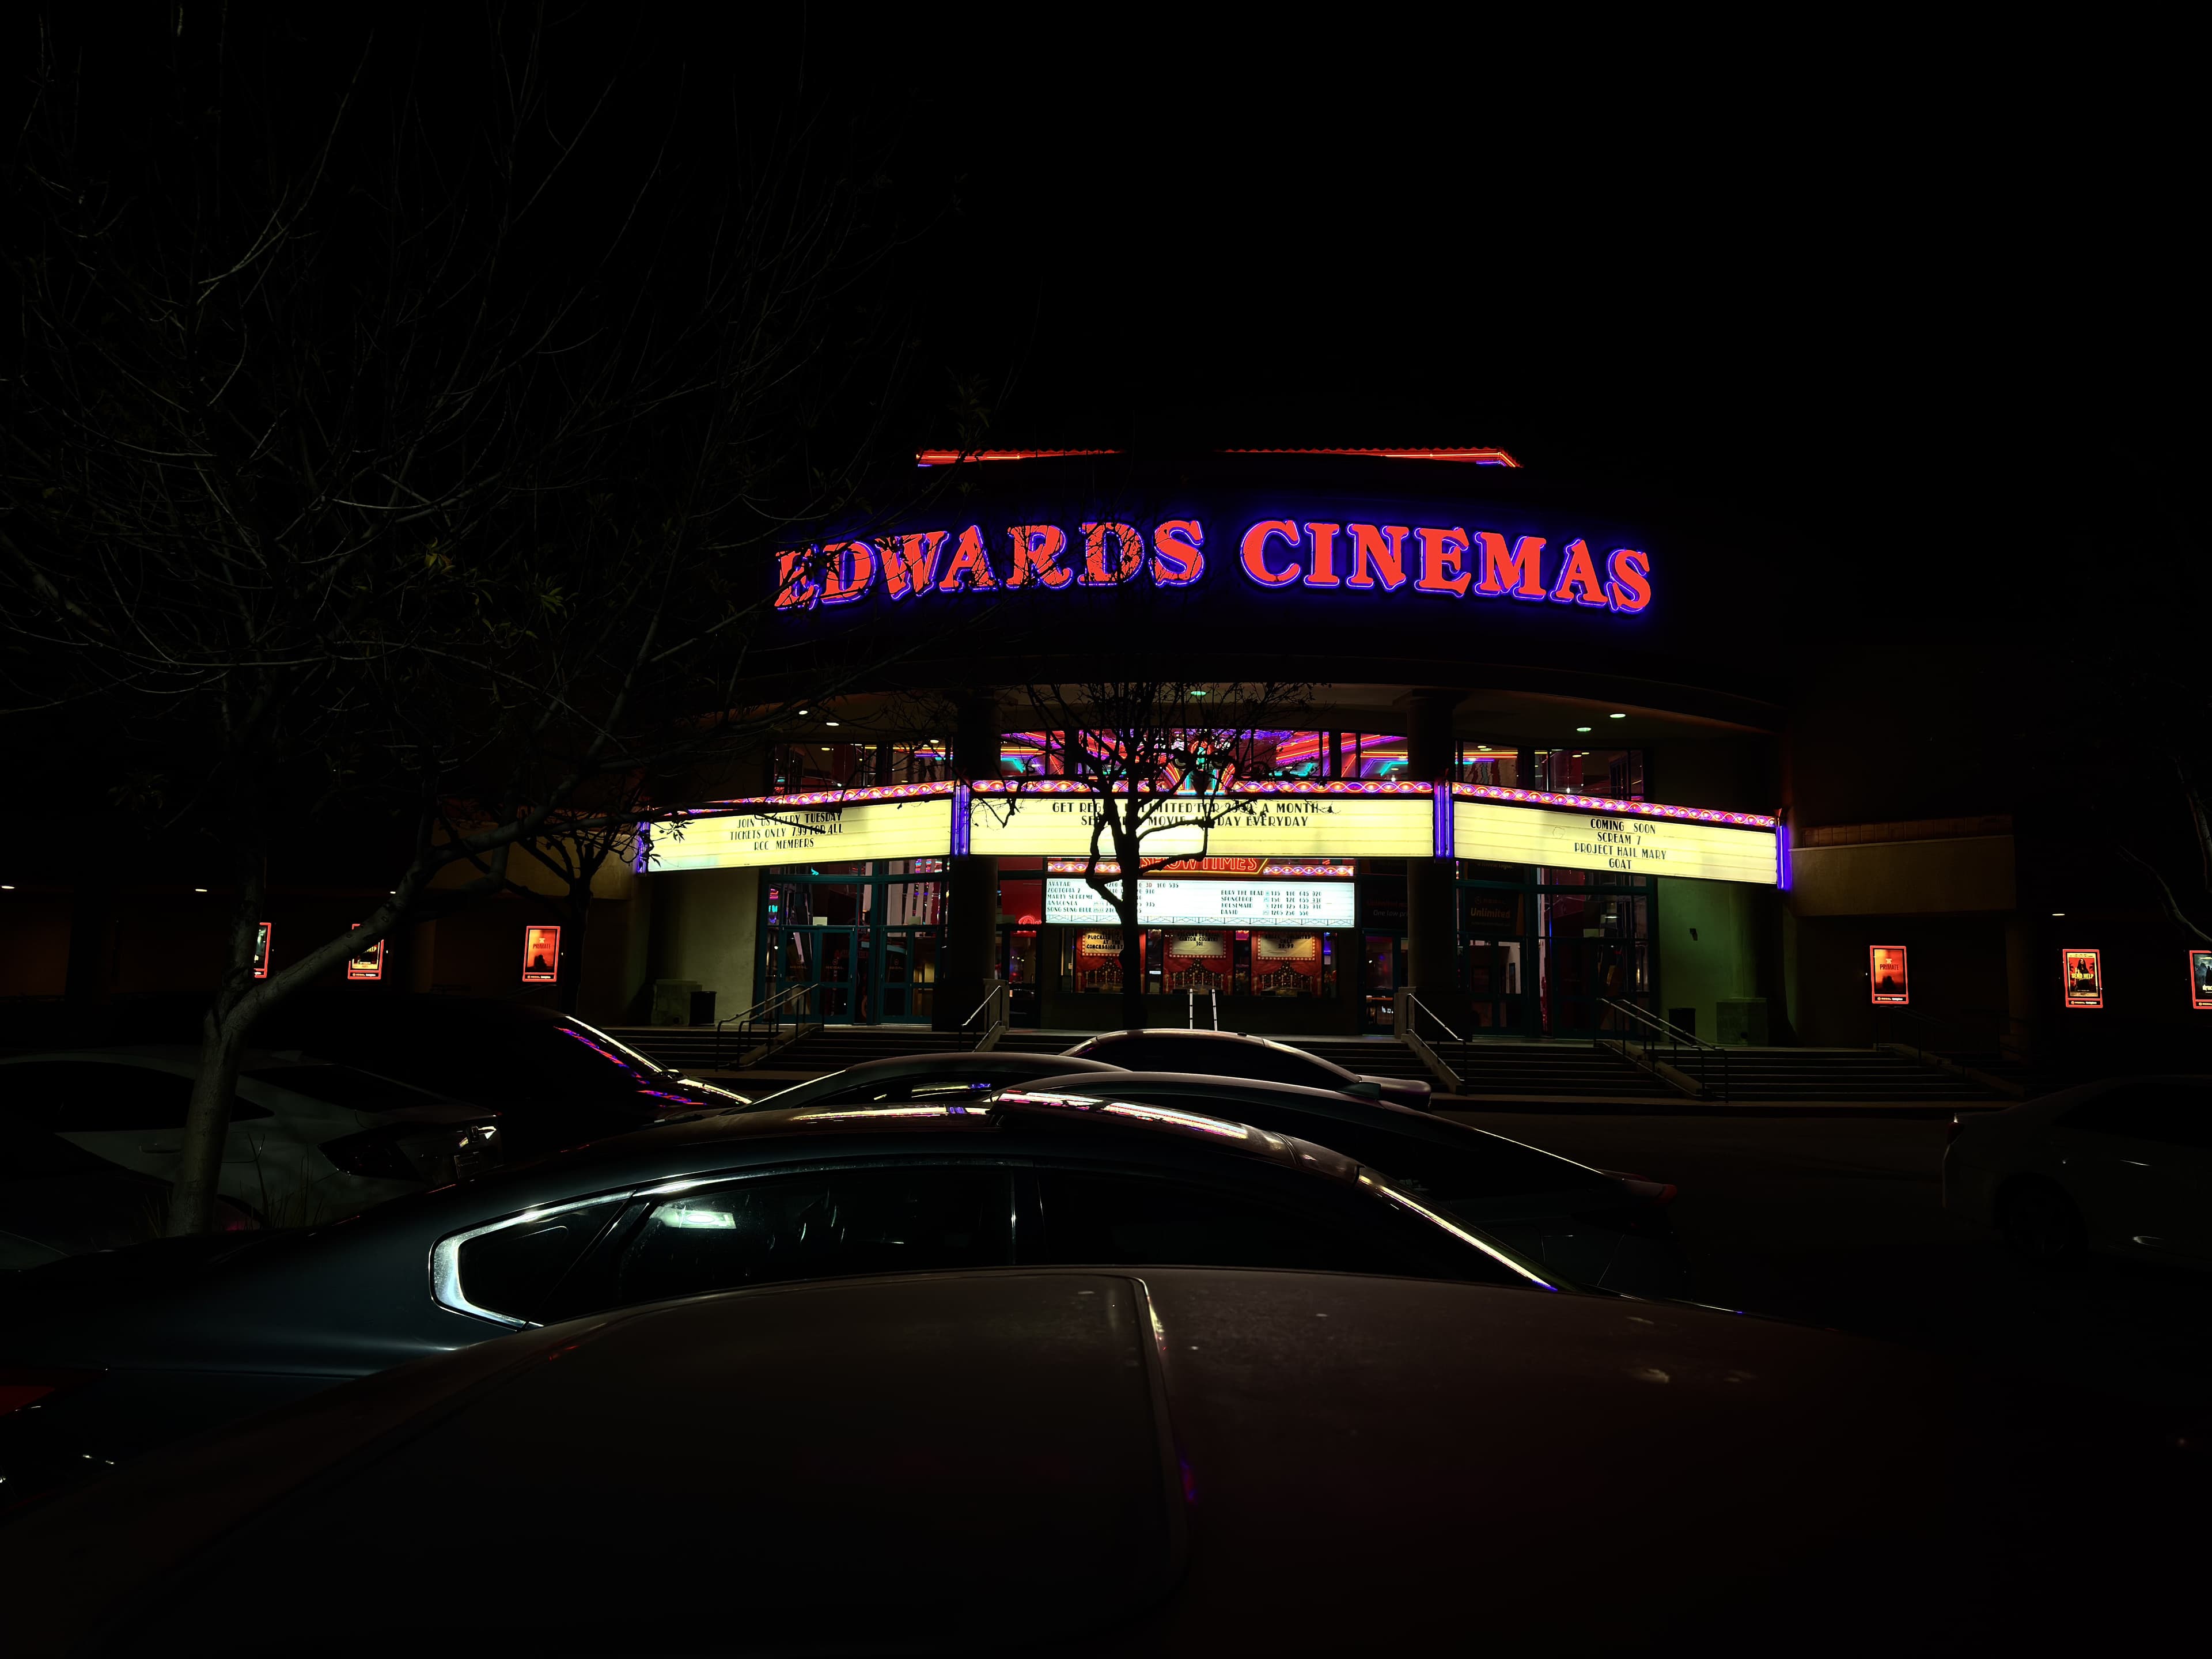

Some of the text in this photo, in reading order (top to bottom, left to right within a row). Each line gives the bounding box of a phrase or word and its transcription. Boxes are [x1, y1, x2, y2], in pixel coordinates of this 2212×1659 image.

[774, 520, 1652, 612] EDWARDS CINEMAS
[1052, 802, 1074, 813] GET
[1262, 803, 1270, 813] A
[1277, 802, 1319, 813] MONTH
[737, 819, 755, 828] JOIN
[761, 817, 770, 826] US
[804, 812, 843, 824] TUESDAY
[1218, 816, 1241, 826] DAY
[1247, 816, 1308, 827] EVERYDAY
[1590, 818, 1656, 834] COMING SOON
[730, 829, 762, 840] TICKETS
[765, 828, 786, 839] ONLY
[792, 826, 806, 836] 7.99
[827, 823, 843, 835] ALL
[1597, 831, 1641, 846] SCREAM 7
[754, 838, 814, 851] RCC MEMBERS
[1574, 842, 1666, 860] PROJECT HAIL MARY
[1609, 858, 1632, 869] GOAT
